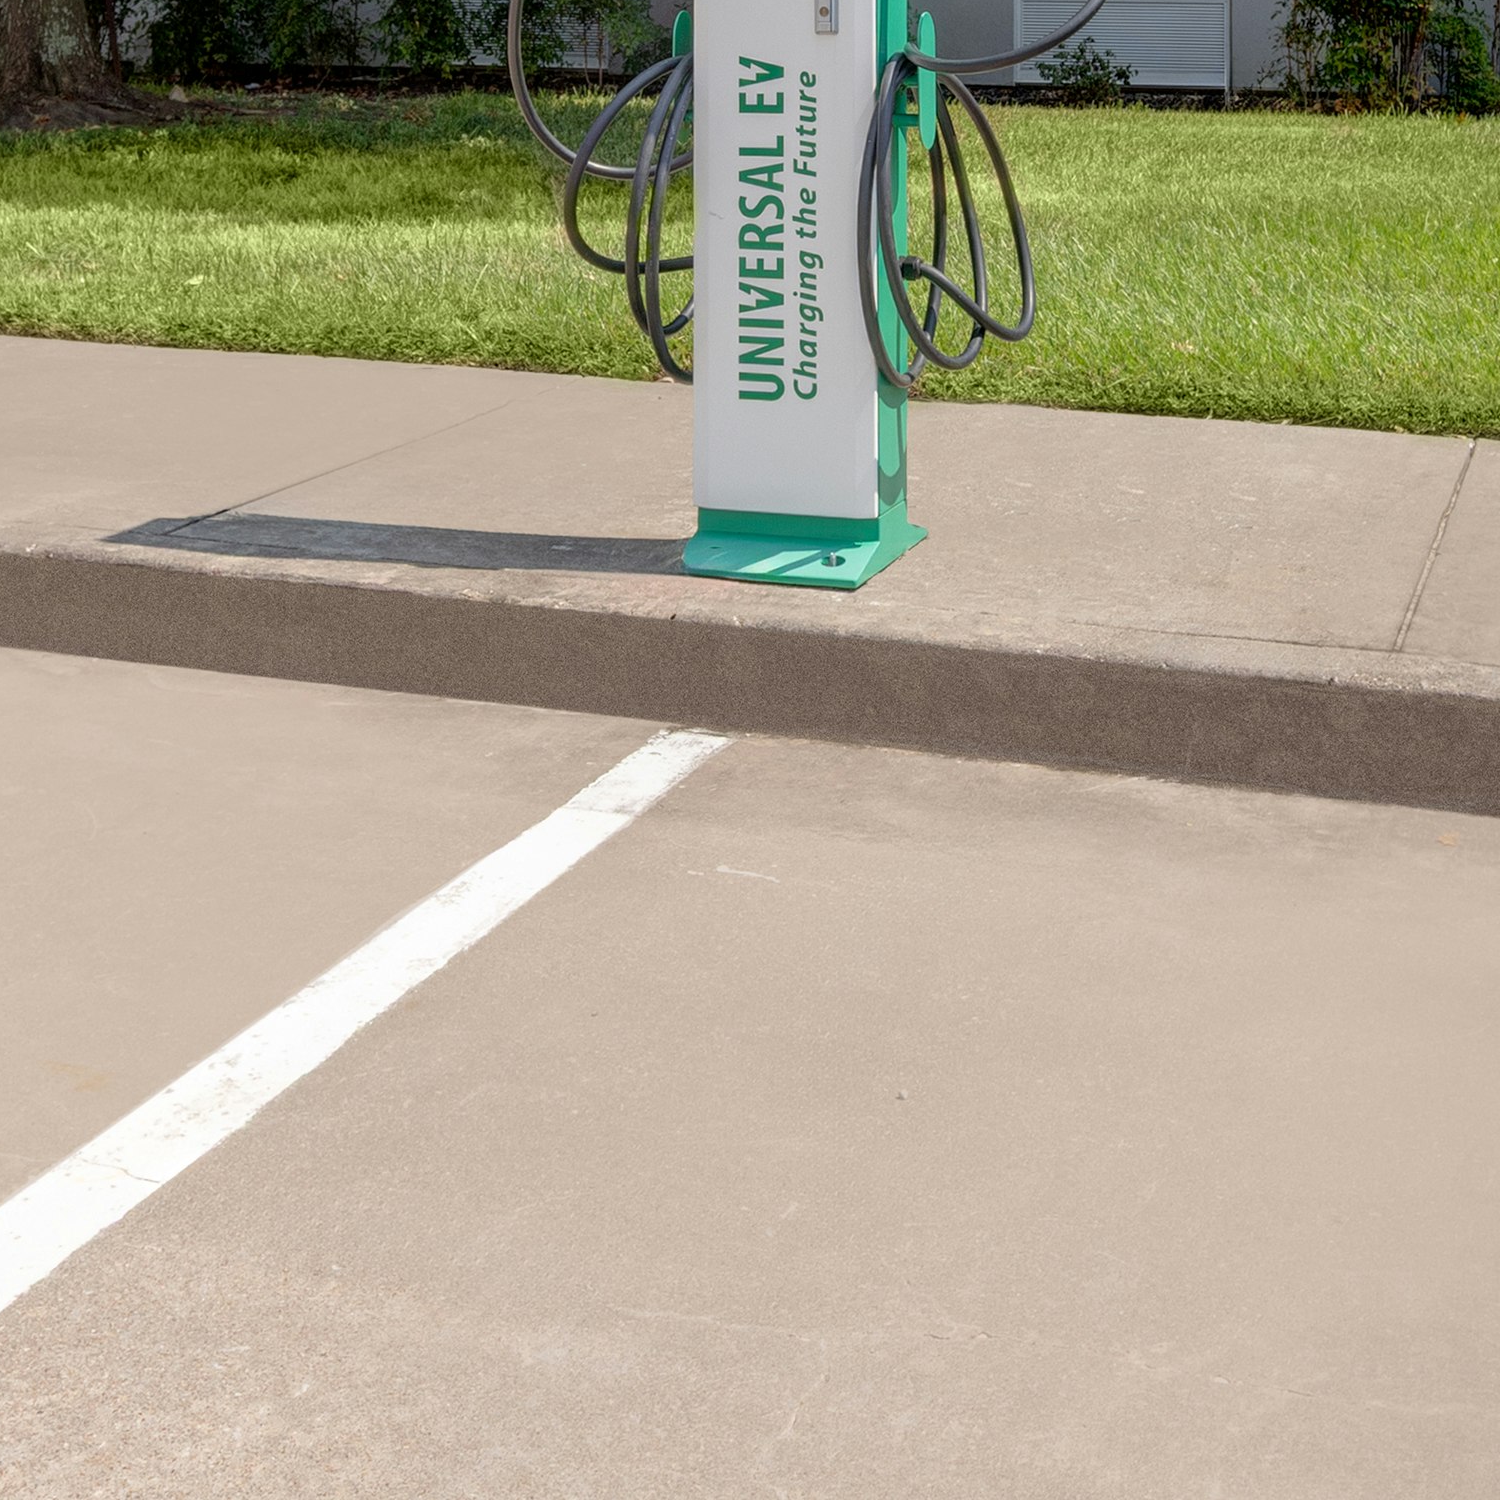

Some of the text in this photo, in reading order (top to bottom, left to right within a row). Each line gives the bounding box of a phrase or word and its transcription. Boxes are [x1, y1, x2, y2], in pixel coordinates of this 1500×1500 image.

[738, 55, 785, 401] UNIVERSAL EV
[792, 70, 824, 400] Charging the Future
